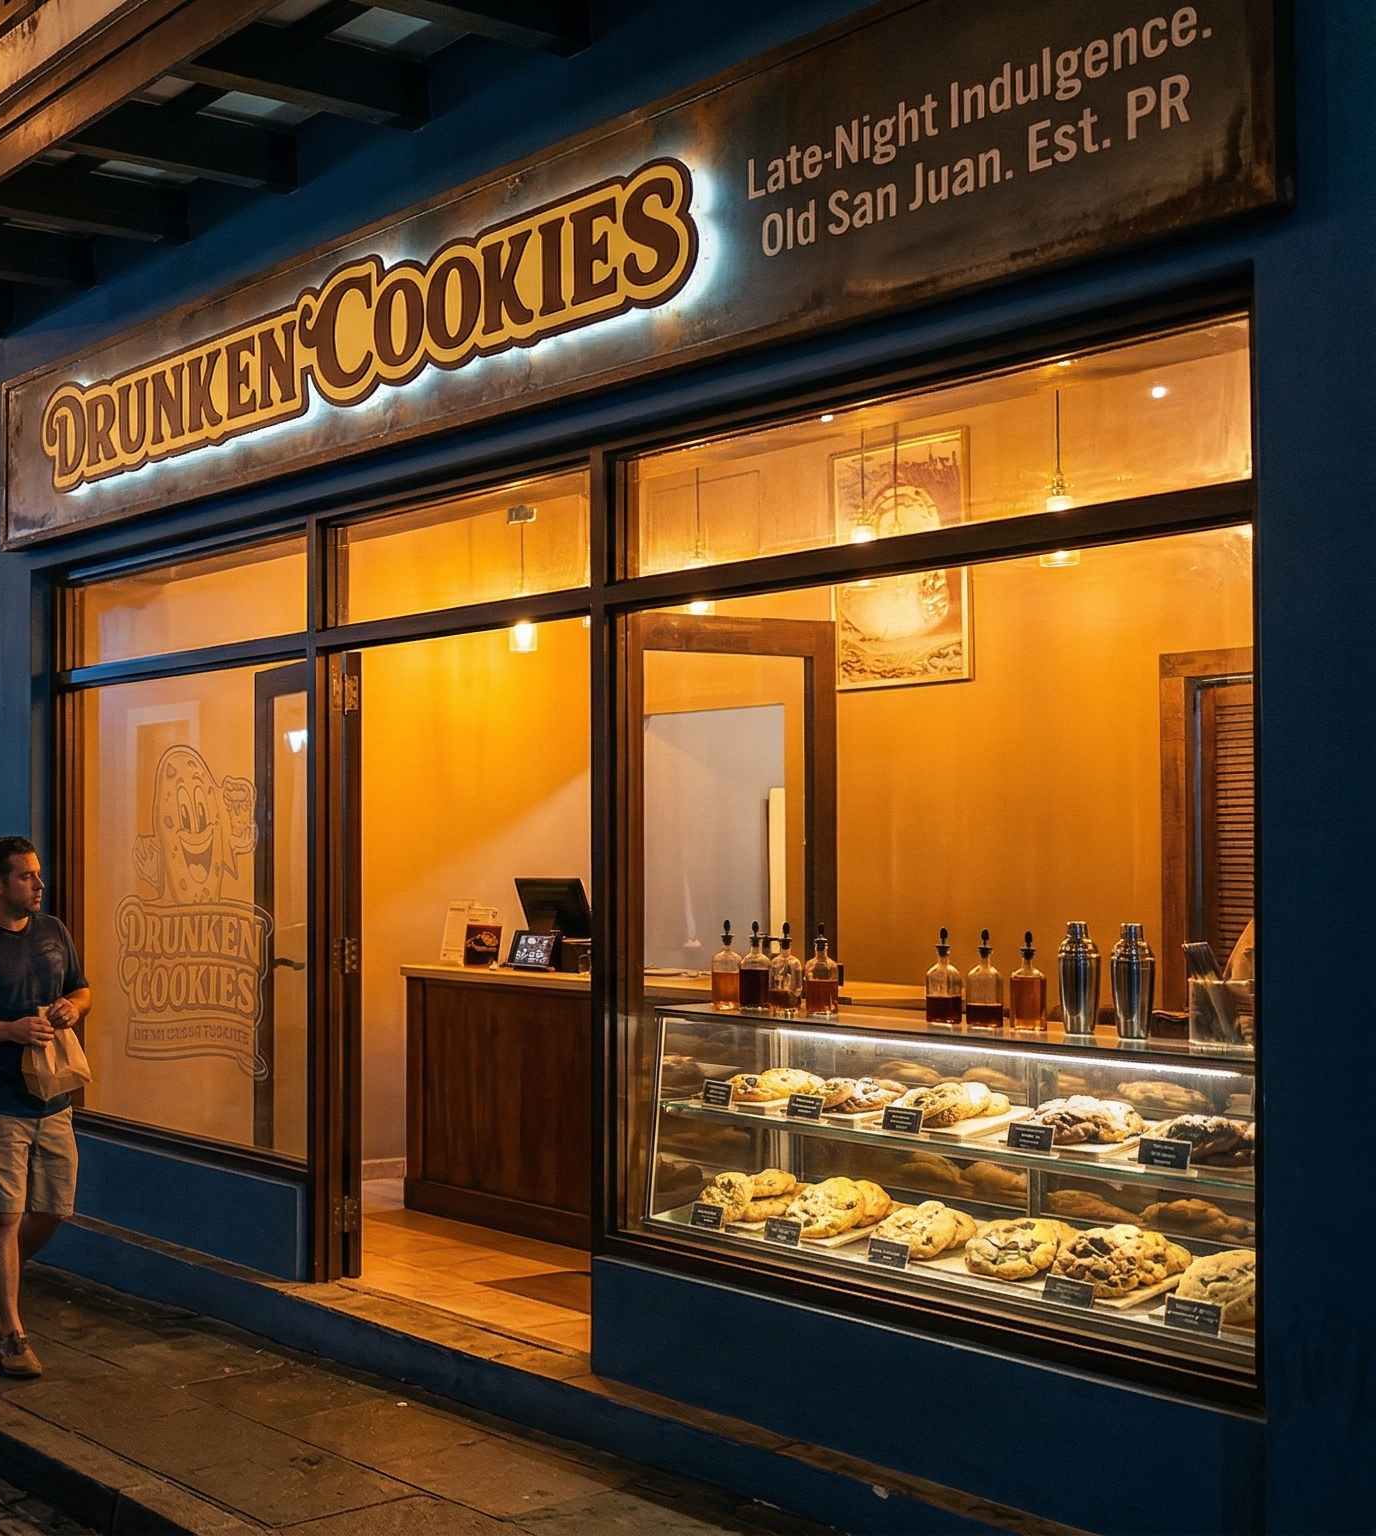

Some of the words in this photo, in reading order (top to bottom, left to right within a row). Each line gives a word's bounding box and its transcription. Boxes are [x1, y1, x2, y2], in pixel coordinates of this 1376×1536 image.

[748, 93, 939, 200] Late-Night
[950, 6, 1212, 129] Indulgence.
[761, 199, 816, 257] Old
[827, 183, 897, 235] San
[909, 148, 1013, 211] Juan.
[1028, 107, 1111, 172] Est.
[1127, 74, 1190, 141] PR
[44, 318, 299, 479] DRUNKEN
[297, 176, 682, 391] COOKIES
[121, 910, 263, 966] DRUNKEN
[135, 964, 256, 1014] COOKIES
